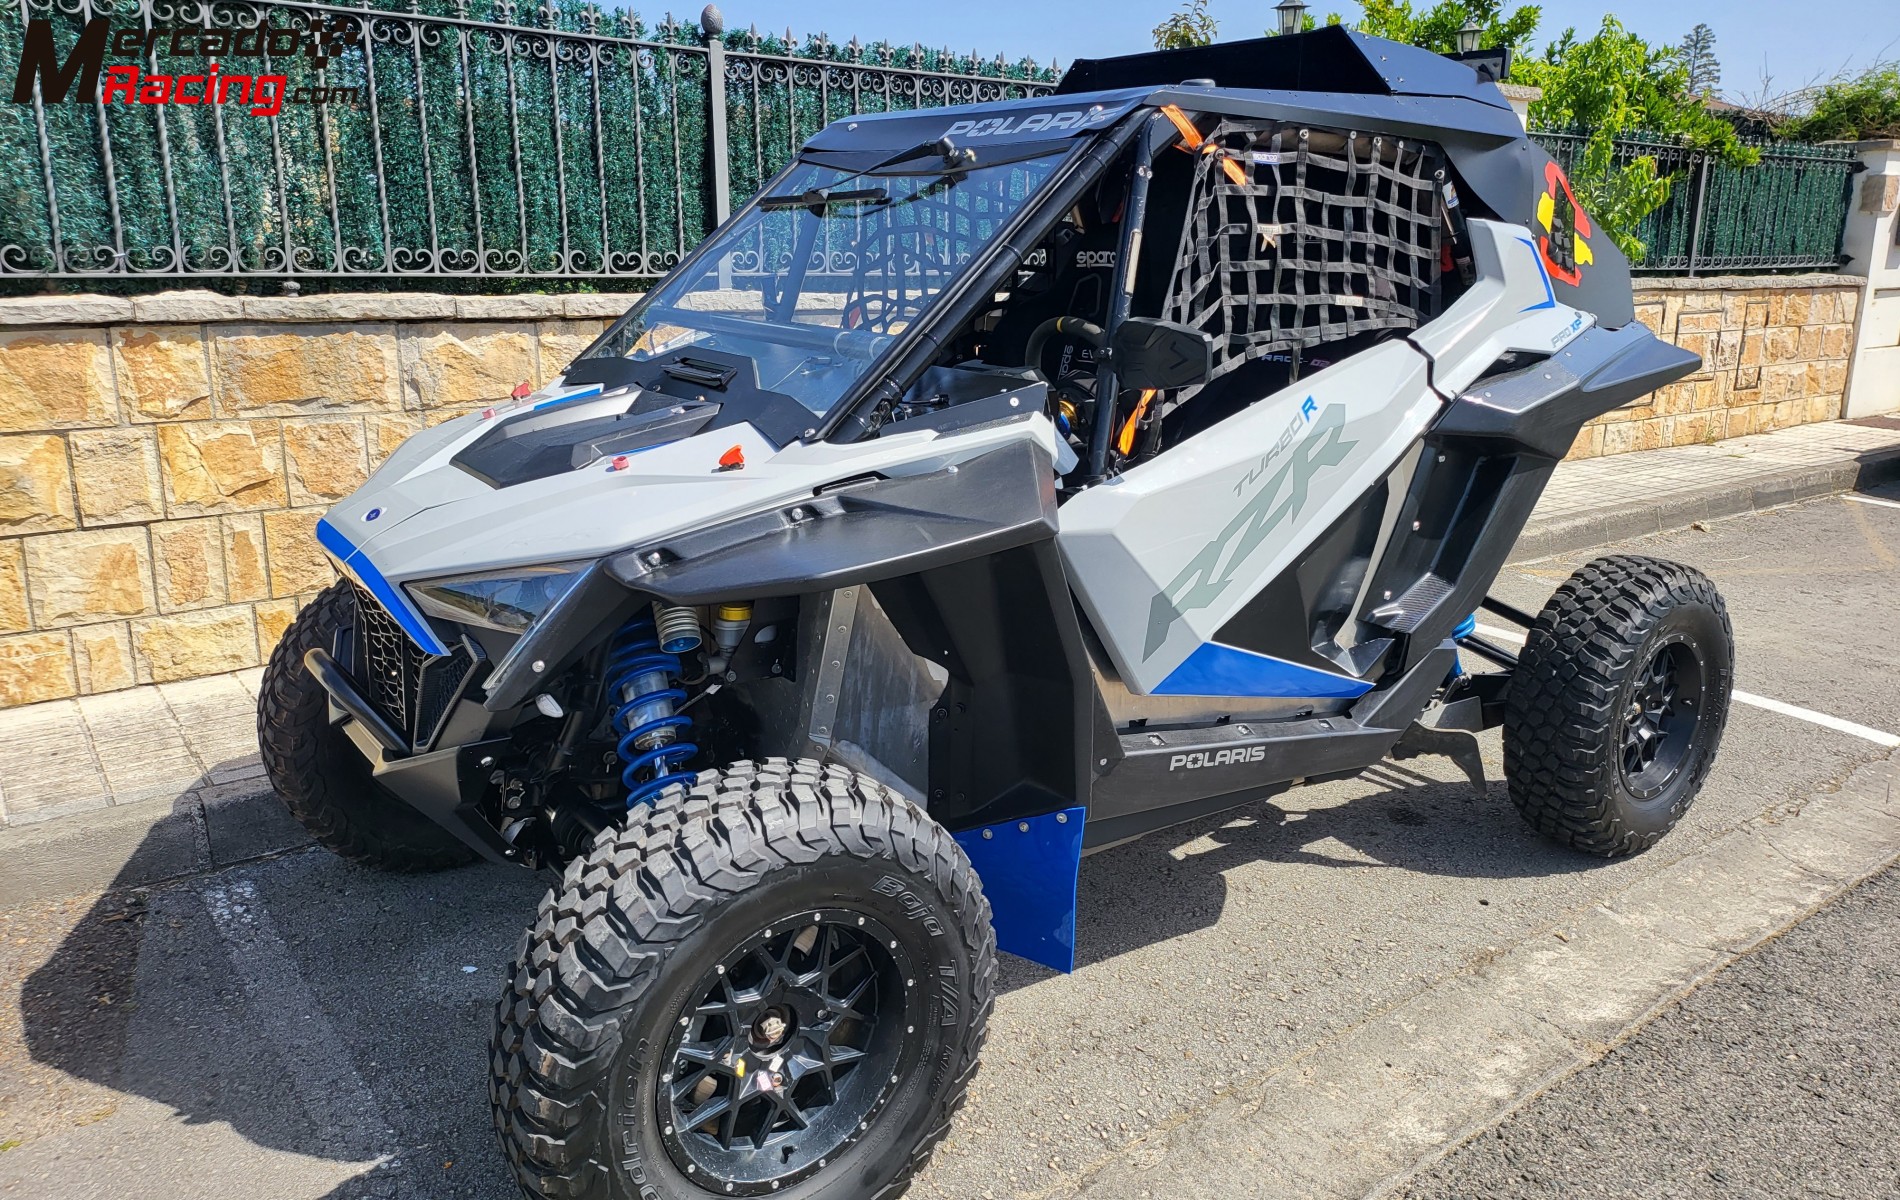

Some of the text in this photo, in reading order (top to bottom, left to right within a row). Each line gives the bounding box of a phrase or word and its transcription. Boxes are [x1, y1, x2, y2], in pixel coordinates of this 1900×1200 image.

[939, 107, 1126, 140] POLARIS
[1076, 251, 1116, 268] sparc
[1551, 318, 1582, 348] PRO XP
[1232, 395, 1318, 498] TURBO R
[1142, 403, 1360, 664] RZR
[1169, 745, 1266, 771] POLARIS
[871, 875, 946, 937] Baja
[938, 959, 960, 1027] T/A
